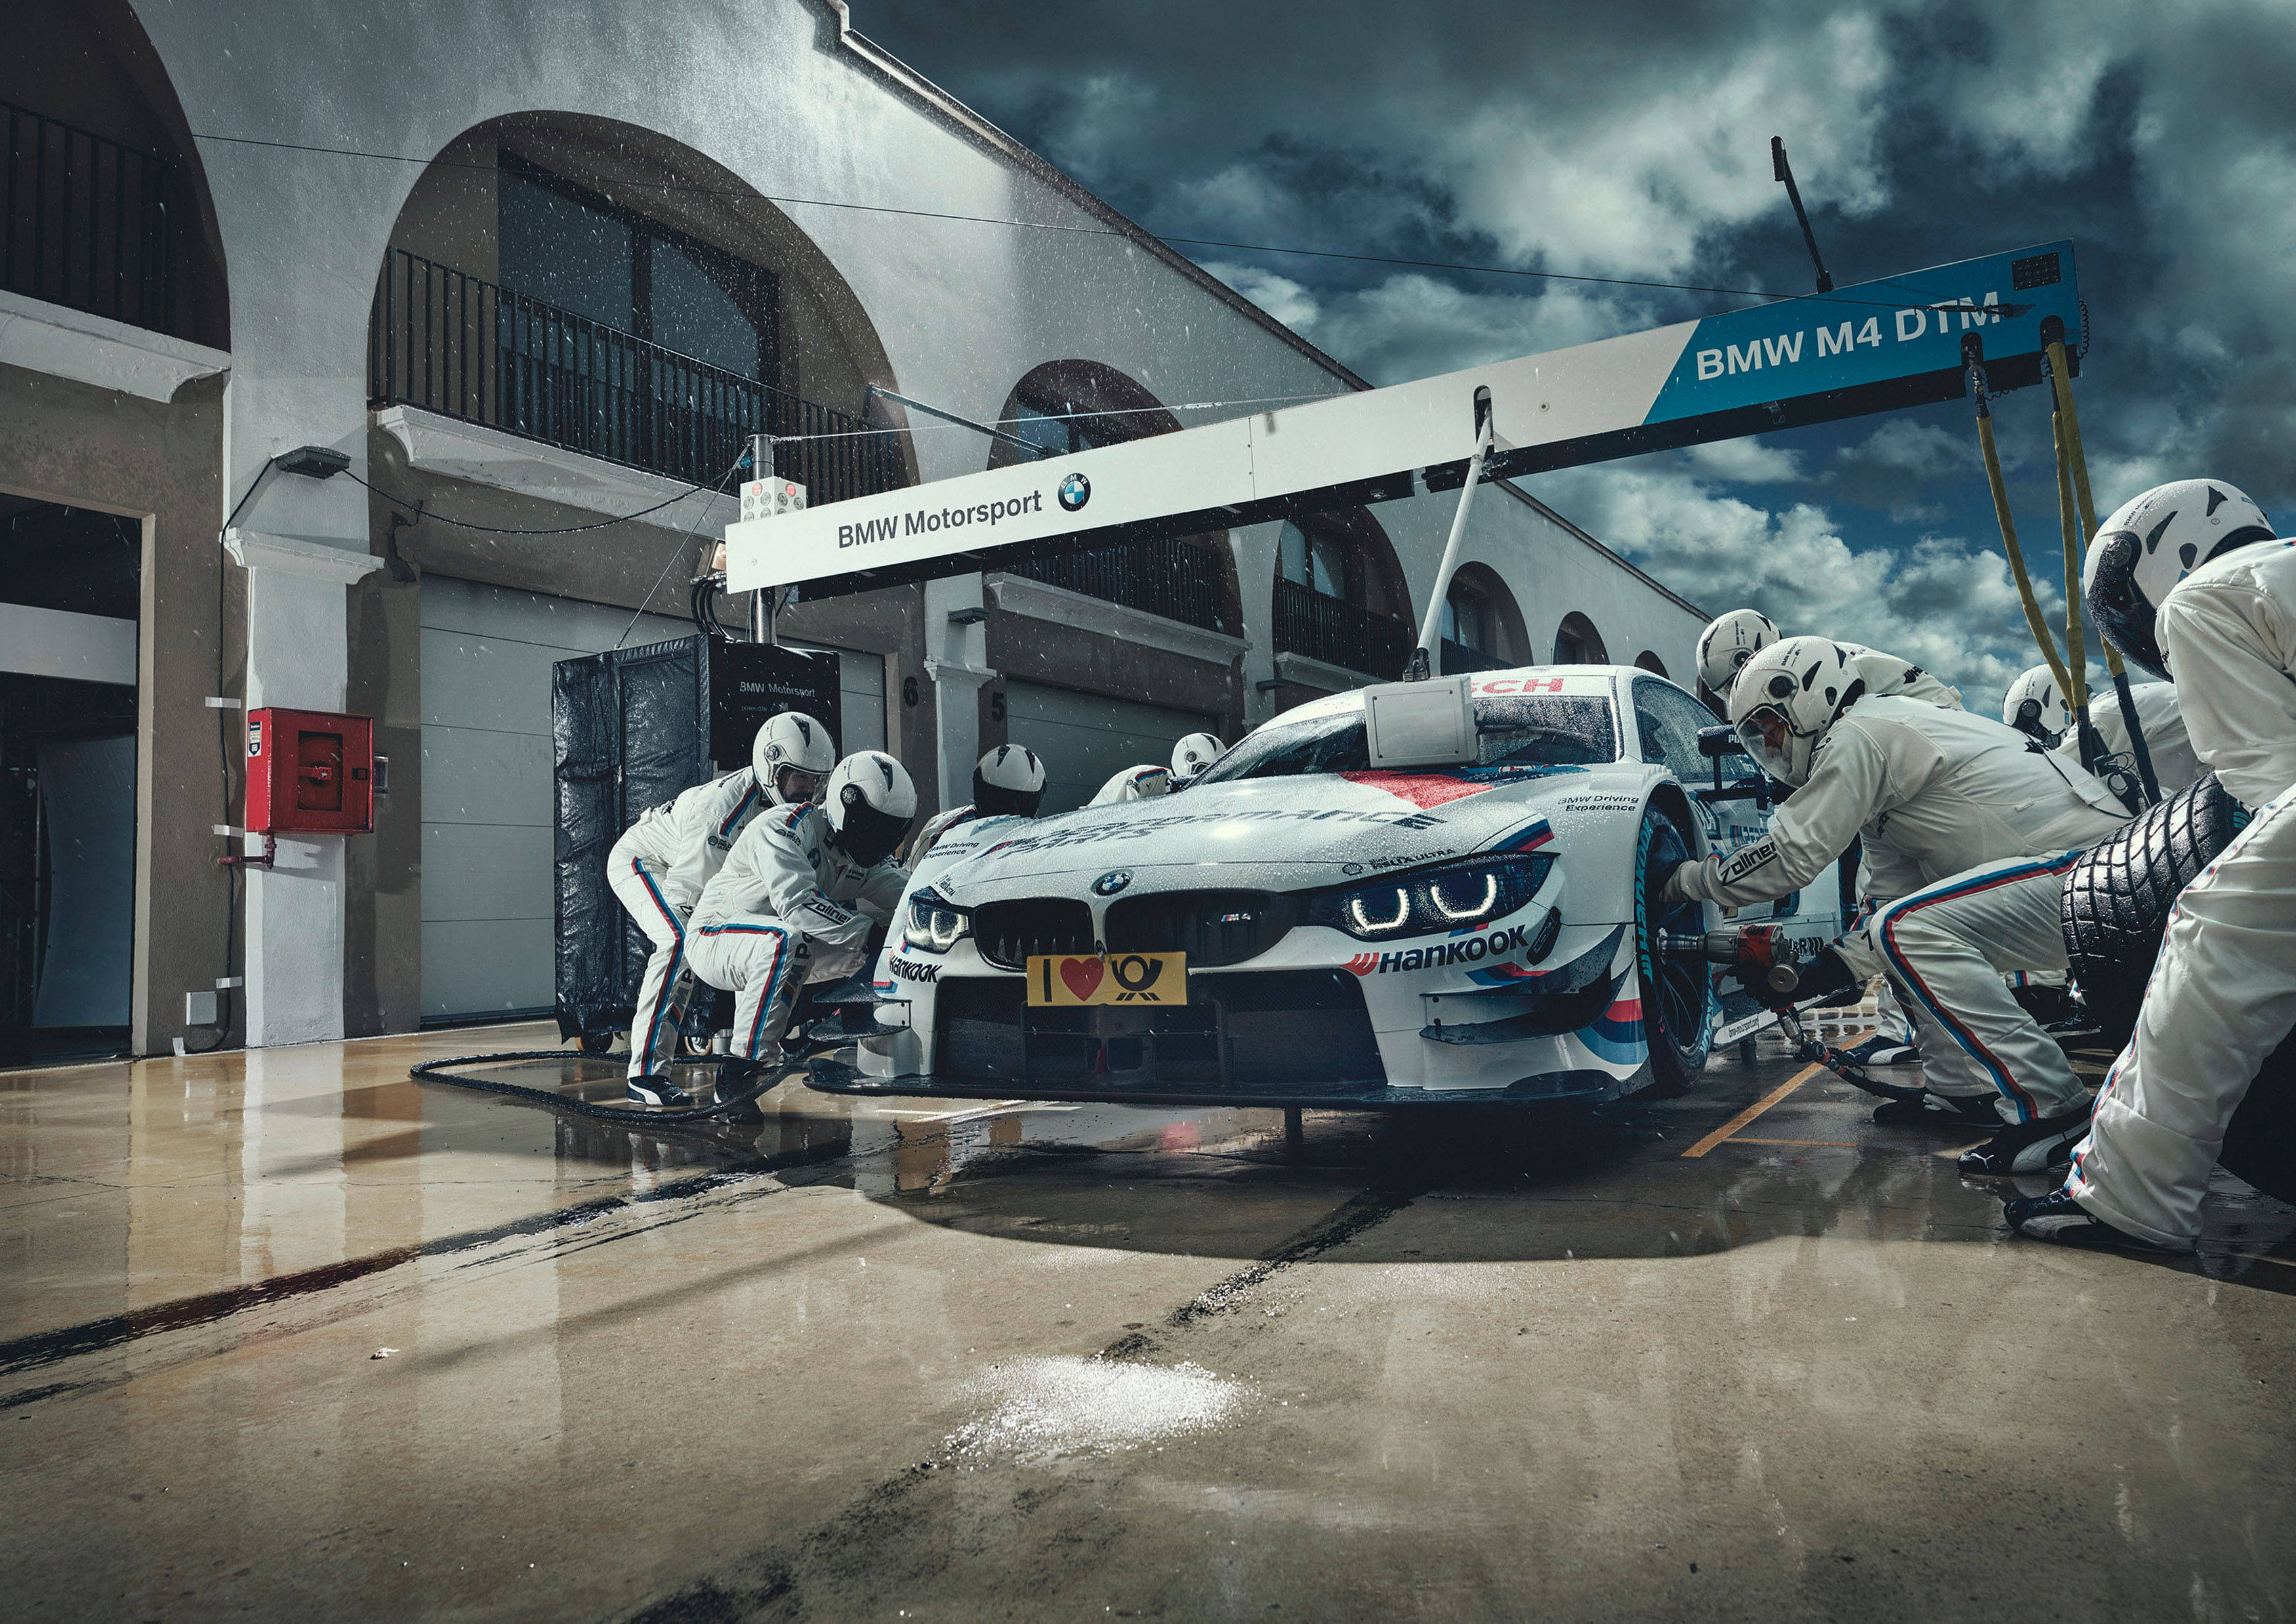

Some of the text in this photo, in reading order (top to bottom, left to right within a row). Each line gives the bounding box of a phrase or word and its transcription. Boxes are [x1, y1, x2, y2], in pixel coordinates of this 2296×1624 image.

[1696, 291, 2000, 381] BMW M4 DTM
[838, 490, 1042, 549] BMW Motorsport
[739, 681, 816, 697] BMW Motorsport
[904, 677, 918, 707] 6
[991, 692, 1005, 722] 5
[1558, 795, 1639, 804] BMW Driving
[1565, 804, 1636, 812] Experience
[923, 849, 966, 860] Experience
